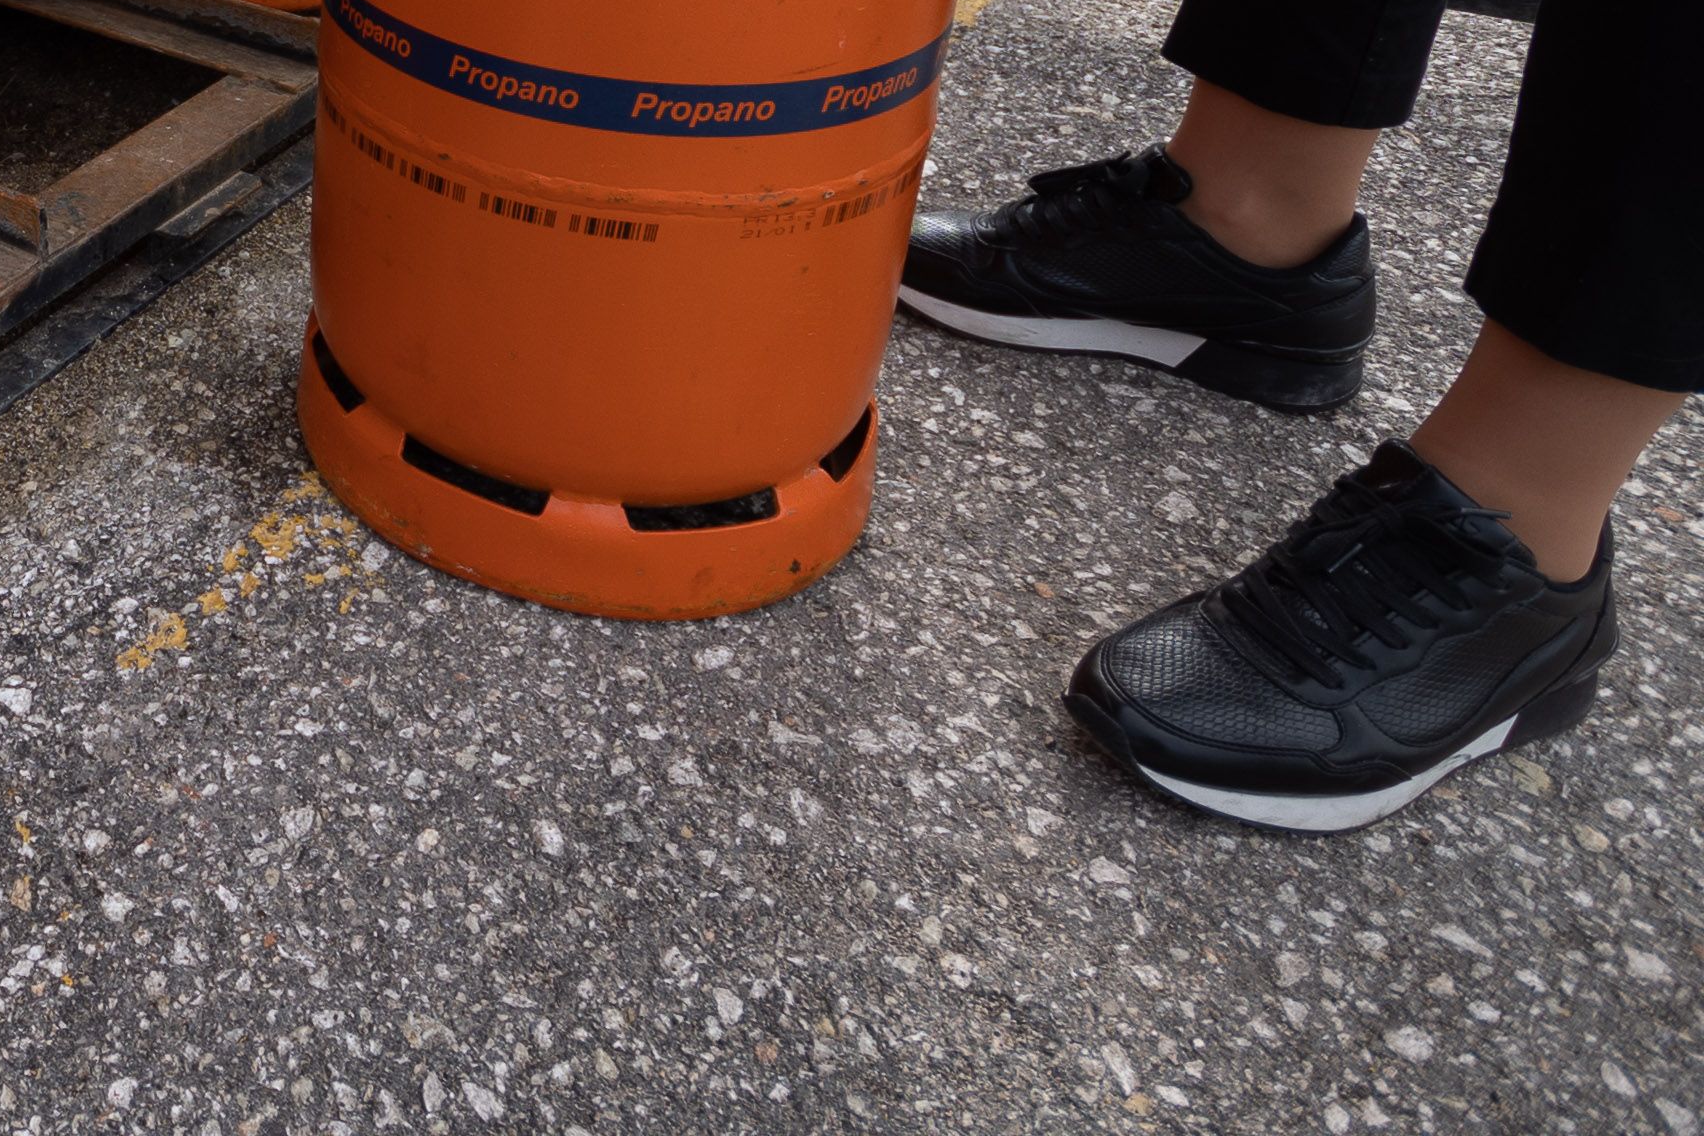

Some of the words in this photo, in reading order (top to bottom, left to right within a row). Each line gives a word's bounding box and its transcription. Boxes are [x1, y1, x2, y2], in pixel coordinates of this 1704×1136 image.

[449, 54, 580, 111] Propano
[632, 91, 777, 130] Propano
[821, 67, 918, 113] Propano
